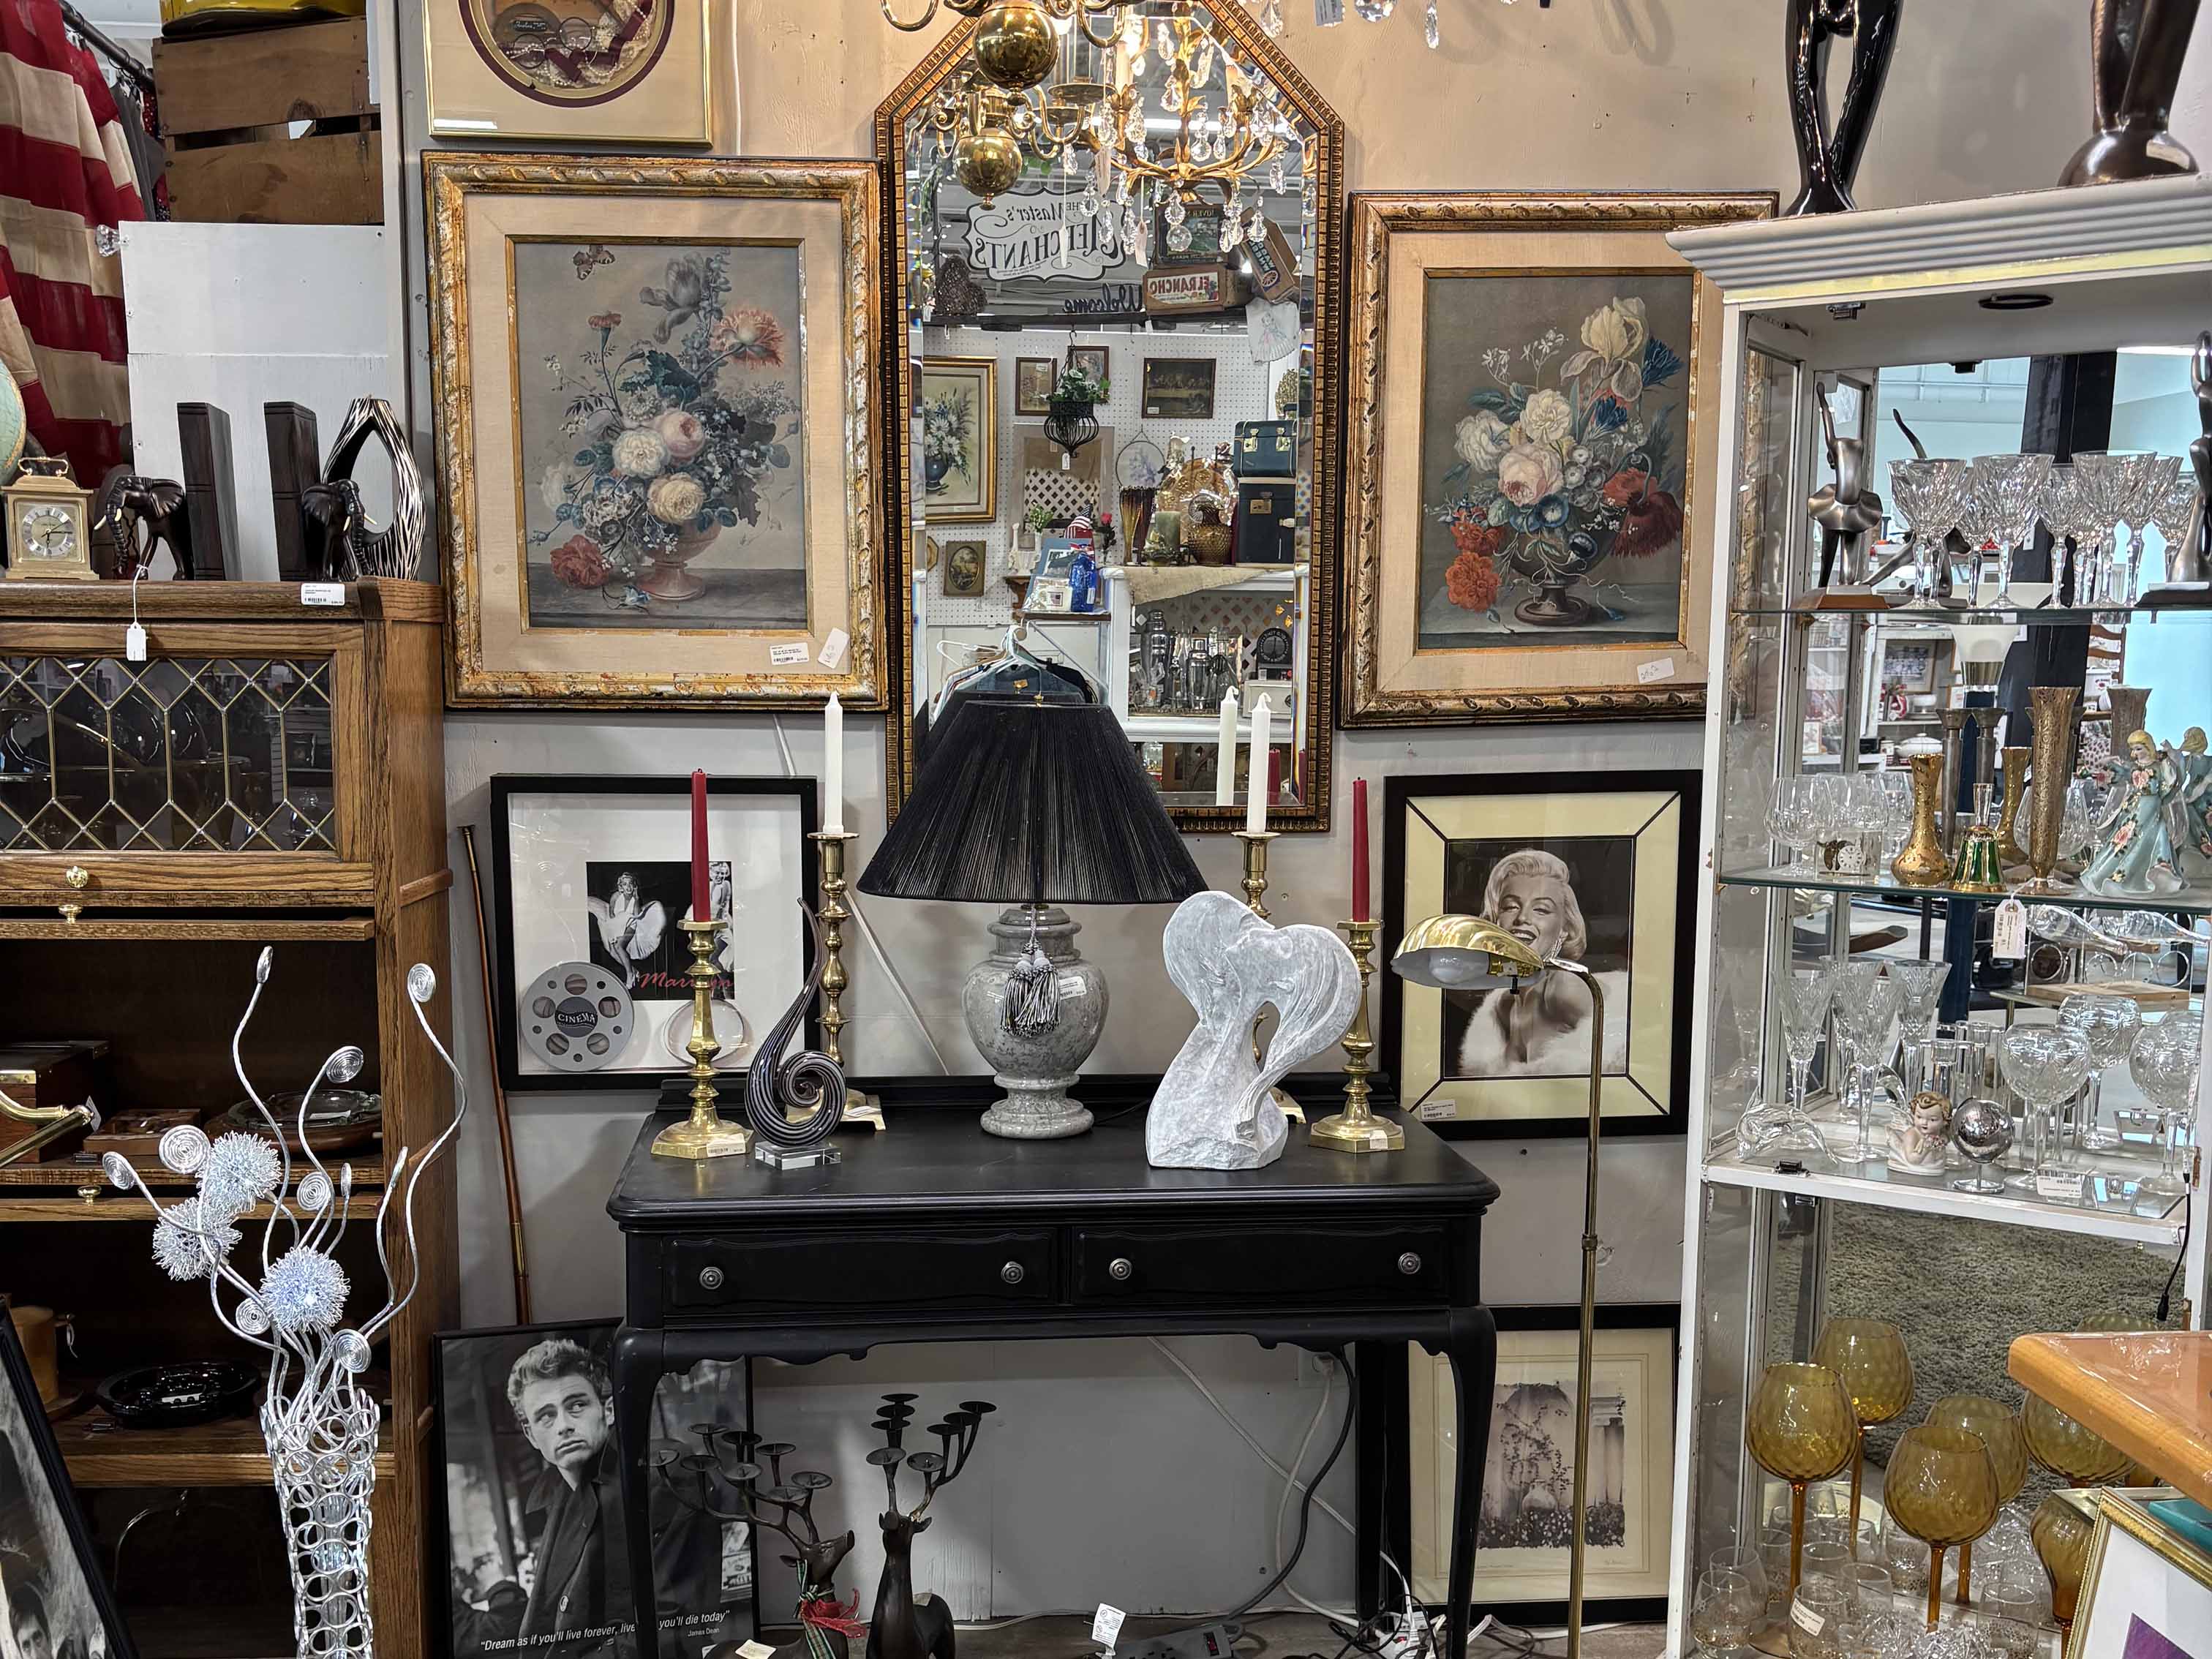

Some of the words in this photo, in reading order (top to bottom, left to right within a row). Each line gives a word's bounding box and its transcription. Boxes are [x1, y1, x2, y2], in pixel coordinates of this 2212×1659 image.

[557, 1012, 597, 1025] CINEMA
[517, 1638, 528, 1647] as
[530, 1635, 538, 1645] if
[565, 1629, 582, 1641] live
[584, 1624, 617, 1639] forever,
[620, 1622, 636, 1633] live
[685, 1614, 699, 1625] die
[706, 1627, 721, 1635] Dean
